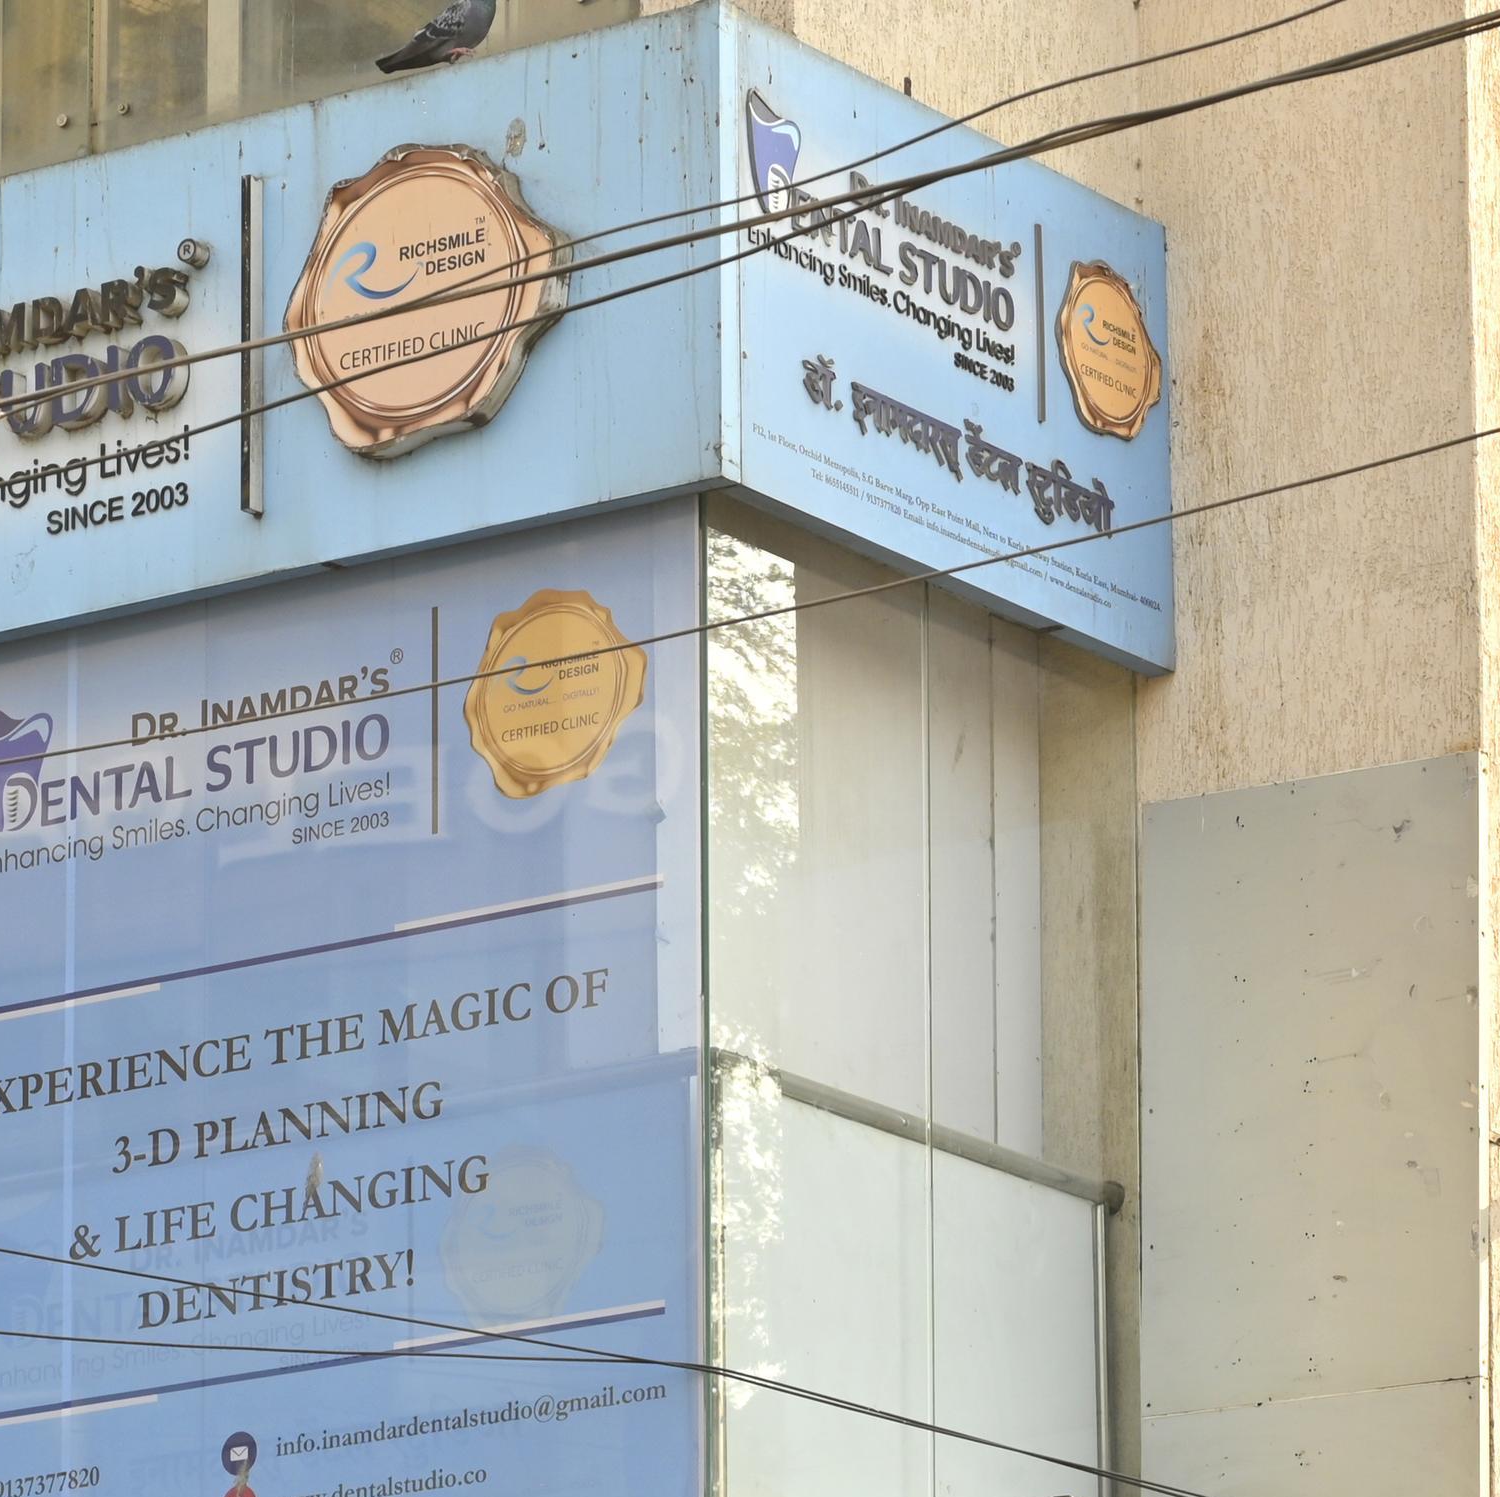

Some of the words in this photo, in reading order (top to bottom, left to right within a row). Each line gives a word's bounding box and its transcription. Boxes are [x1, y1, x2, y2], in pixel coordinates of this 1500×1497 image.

[399, 227, 485, 262] RICHSMILE
[425, 249, 485, 276] DESIGN
[838, 263, 891, 307] Smiles.
[894, 291, 972, 351] Changing
[976, 328, 1015, 365] Lives!
[899, 242, 1014, 331] STUDIO
[340, 336, 425, 371] CERTIFIED
[429, 321, 485, 350] CLINIC
[1102, 320, 1136, 344] RICHSMILE
[1113, 337, 1136, 355] DESIGN
[1080, 364, 1114, 388] CERTIFIED
[1115, 380, 1137, 399] CLINIC
[99, 424, 192, 480] Lives!
[46, 498, 123, 536] SINCE
[130, 481, 189, 514] 2003
[206, 713, 391, 793] STUDIO
[501, 721, 559, 743] CERTIFIED
[561, 712, 600, 731] CLINIC
[112, 816, 190, 852] Smiles.
[196, 788, 321, 836] Changing
[328, 772, 391, 804] Lives!
[264, 1013, 364, 1069] THE
[379, 982, 531, 1056] MAGIC
[546, 969, 610, 1013] OF
[112, 1126, 181, 1175] 3-D
[195, 1080, 443, 1163] PLANNING
[69, 1224, 101, 1261] &
[116, 1201, 217, 1255] LIFE
[231, 1154, 490, 1234] CHANGING
[138, 1249, 416, 1330] DENTISTRY!
[276, 1380, 667, 1458] info.inamdardentalstudio@gmail.com
